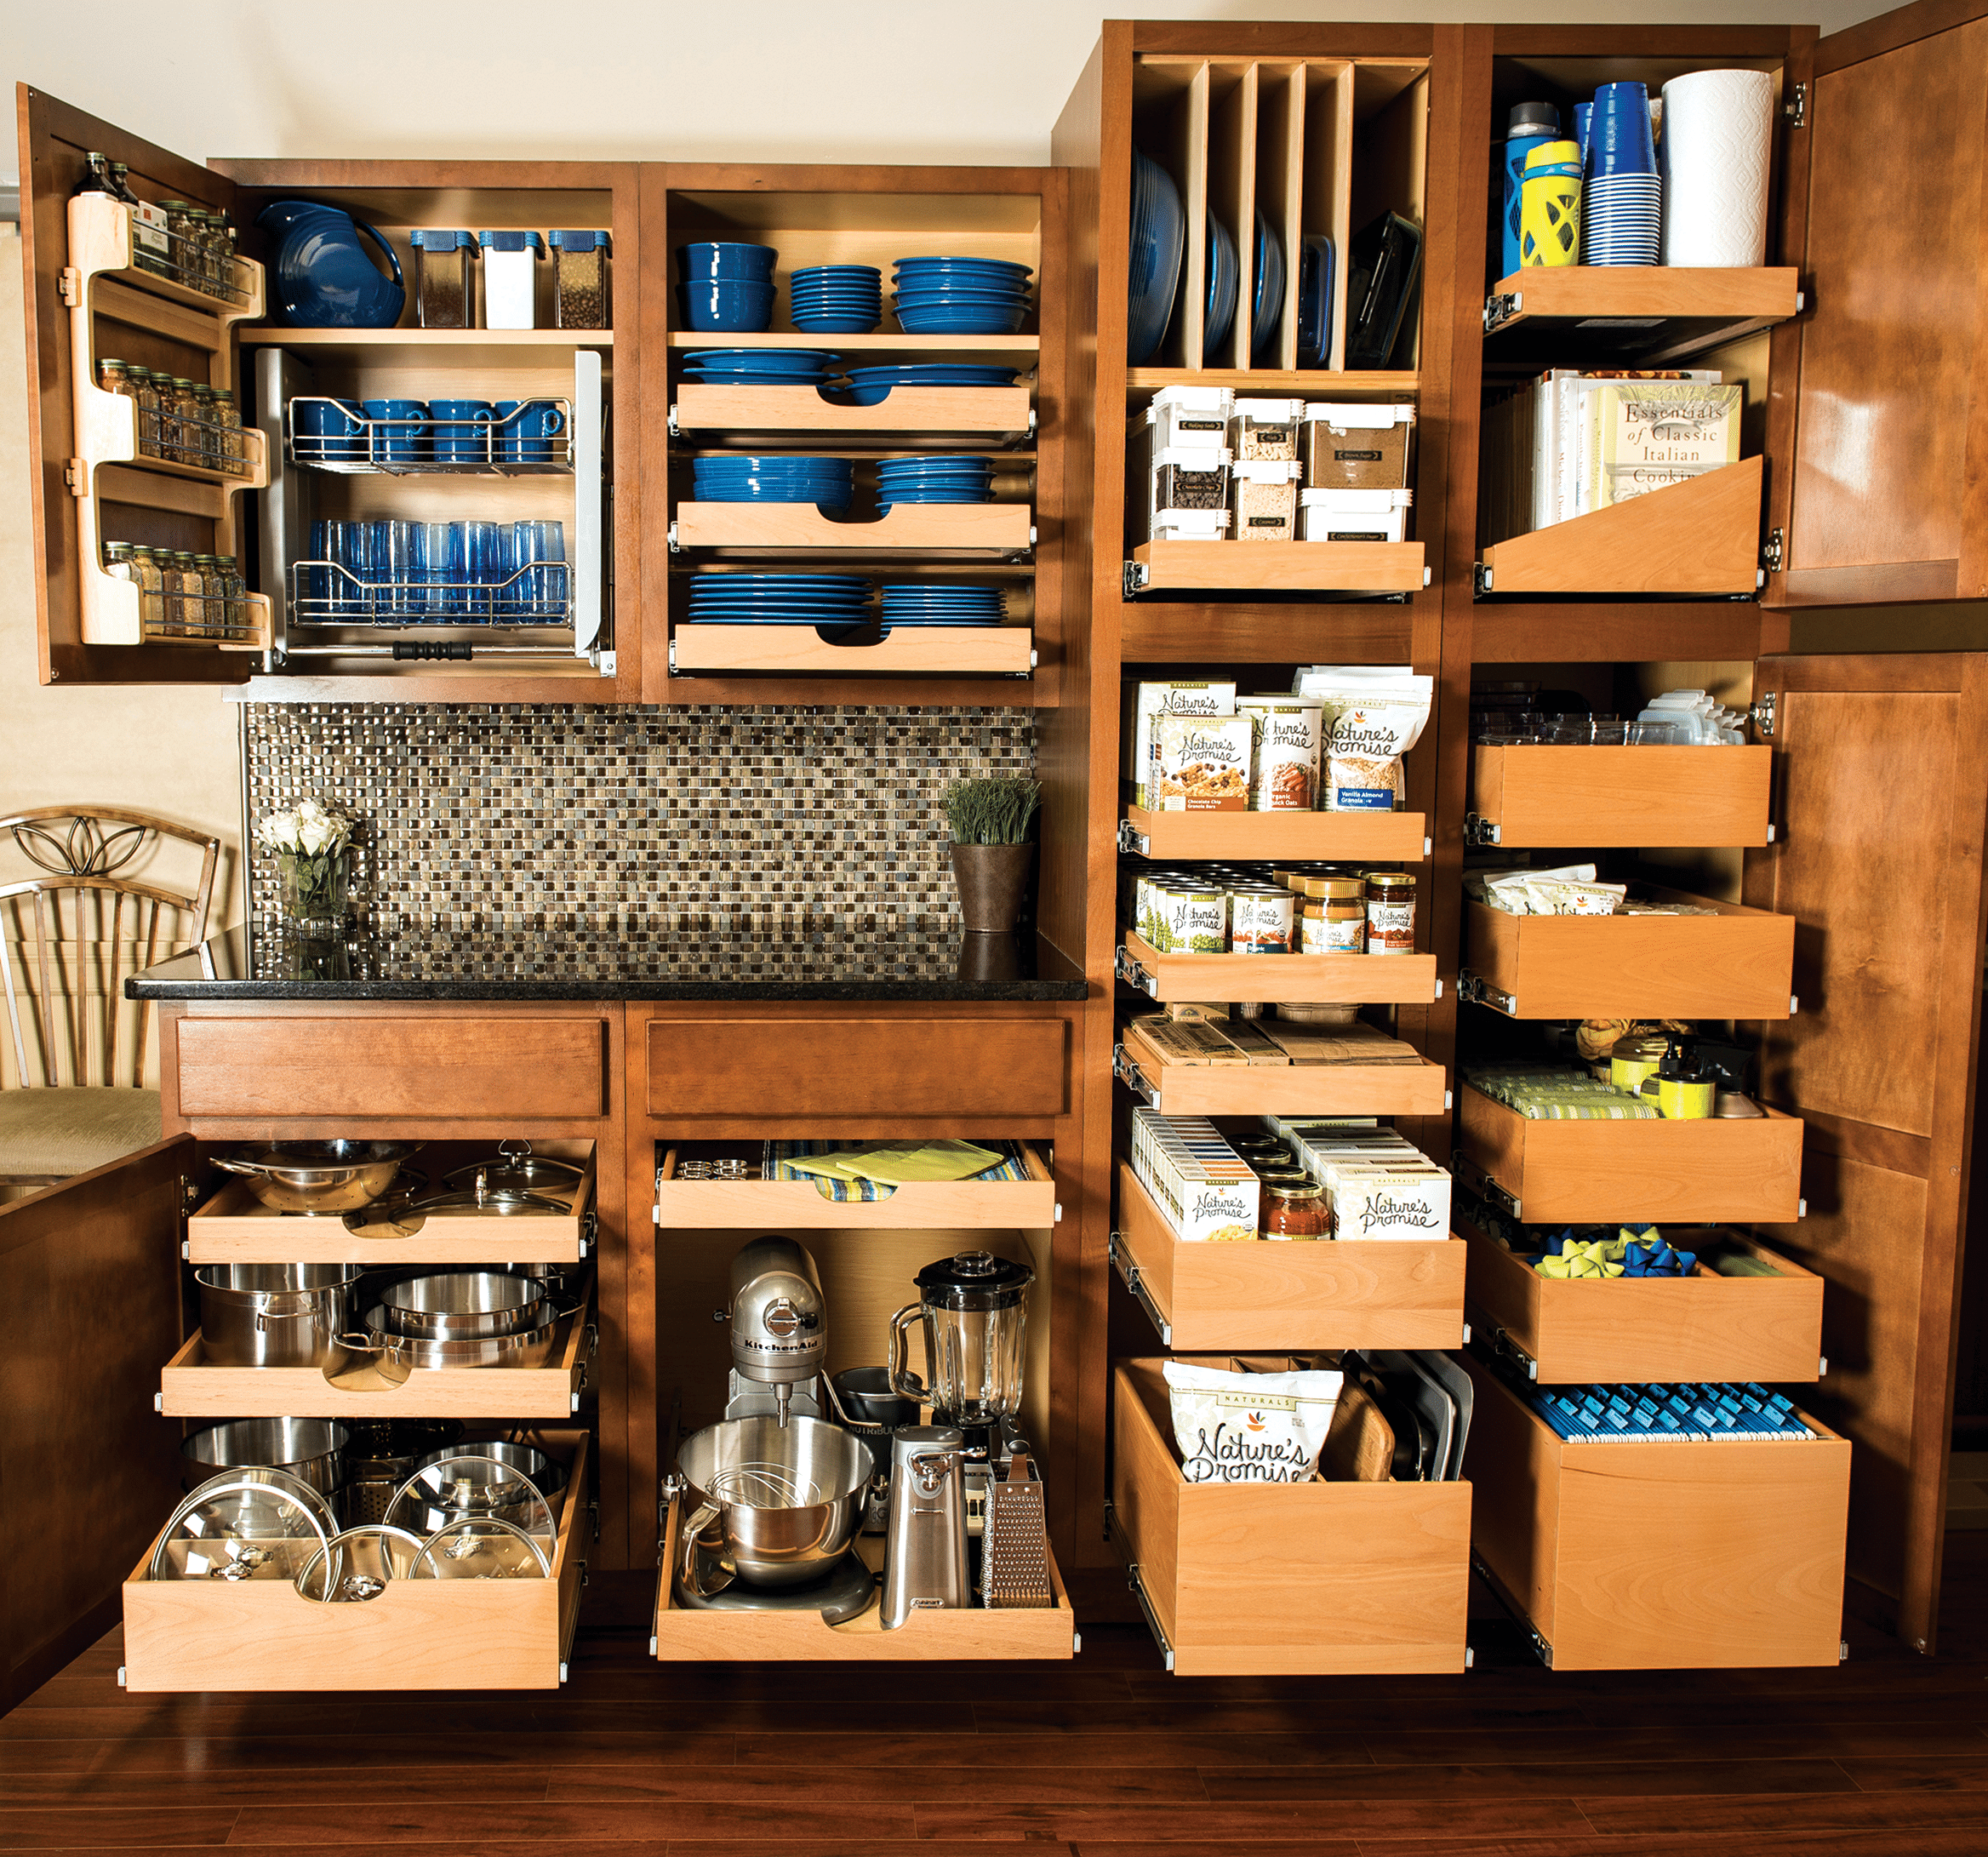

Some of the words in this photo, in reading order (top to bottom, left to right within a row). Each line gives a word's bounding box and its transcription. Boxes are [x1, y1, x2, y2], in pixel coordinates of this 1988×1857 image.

[1625, 404, 1723, 423] Essentials
[1627, 426, 1648, 445] of
[1652, 426, 1717, 442] Classic
[1643, 446, 1700, 460] Italian
[1633, 468, 1695, 483] Cookin
[1163, 690, 1220, 710] Nature's
[1321, 716, 1399, 743] Nature's
[1183, 733, 1236, 751] Nature's
[1252, 734, 1315, 753] Prmise
[1178, 749, 1242, 767] Promise
[1176, 904, 1221, 920] Nature's
[1242, 904, 1279, 918] Naure's
[1378, 908, 1411, 920] Nature's
[1376, 918, 1413, 930] Promise
[1197, 1191, 1246, 1208] Nature's
[1365, 1192, 1432, 1214] Nature's
[1192, 1207, 1252, 1223] Promise
[1359, 1212, 1440, 1234] Promise
[745, 1339, 818, 1351] KitchenAid
[1225, 1396, 1290, 1406] NATURALS
[1196, 1423, 1311, 1466] Nature's
[1189, 1456, 1316, 1483] Promise
